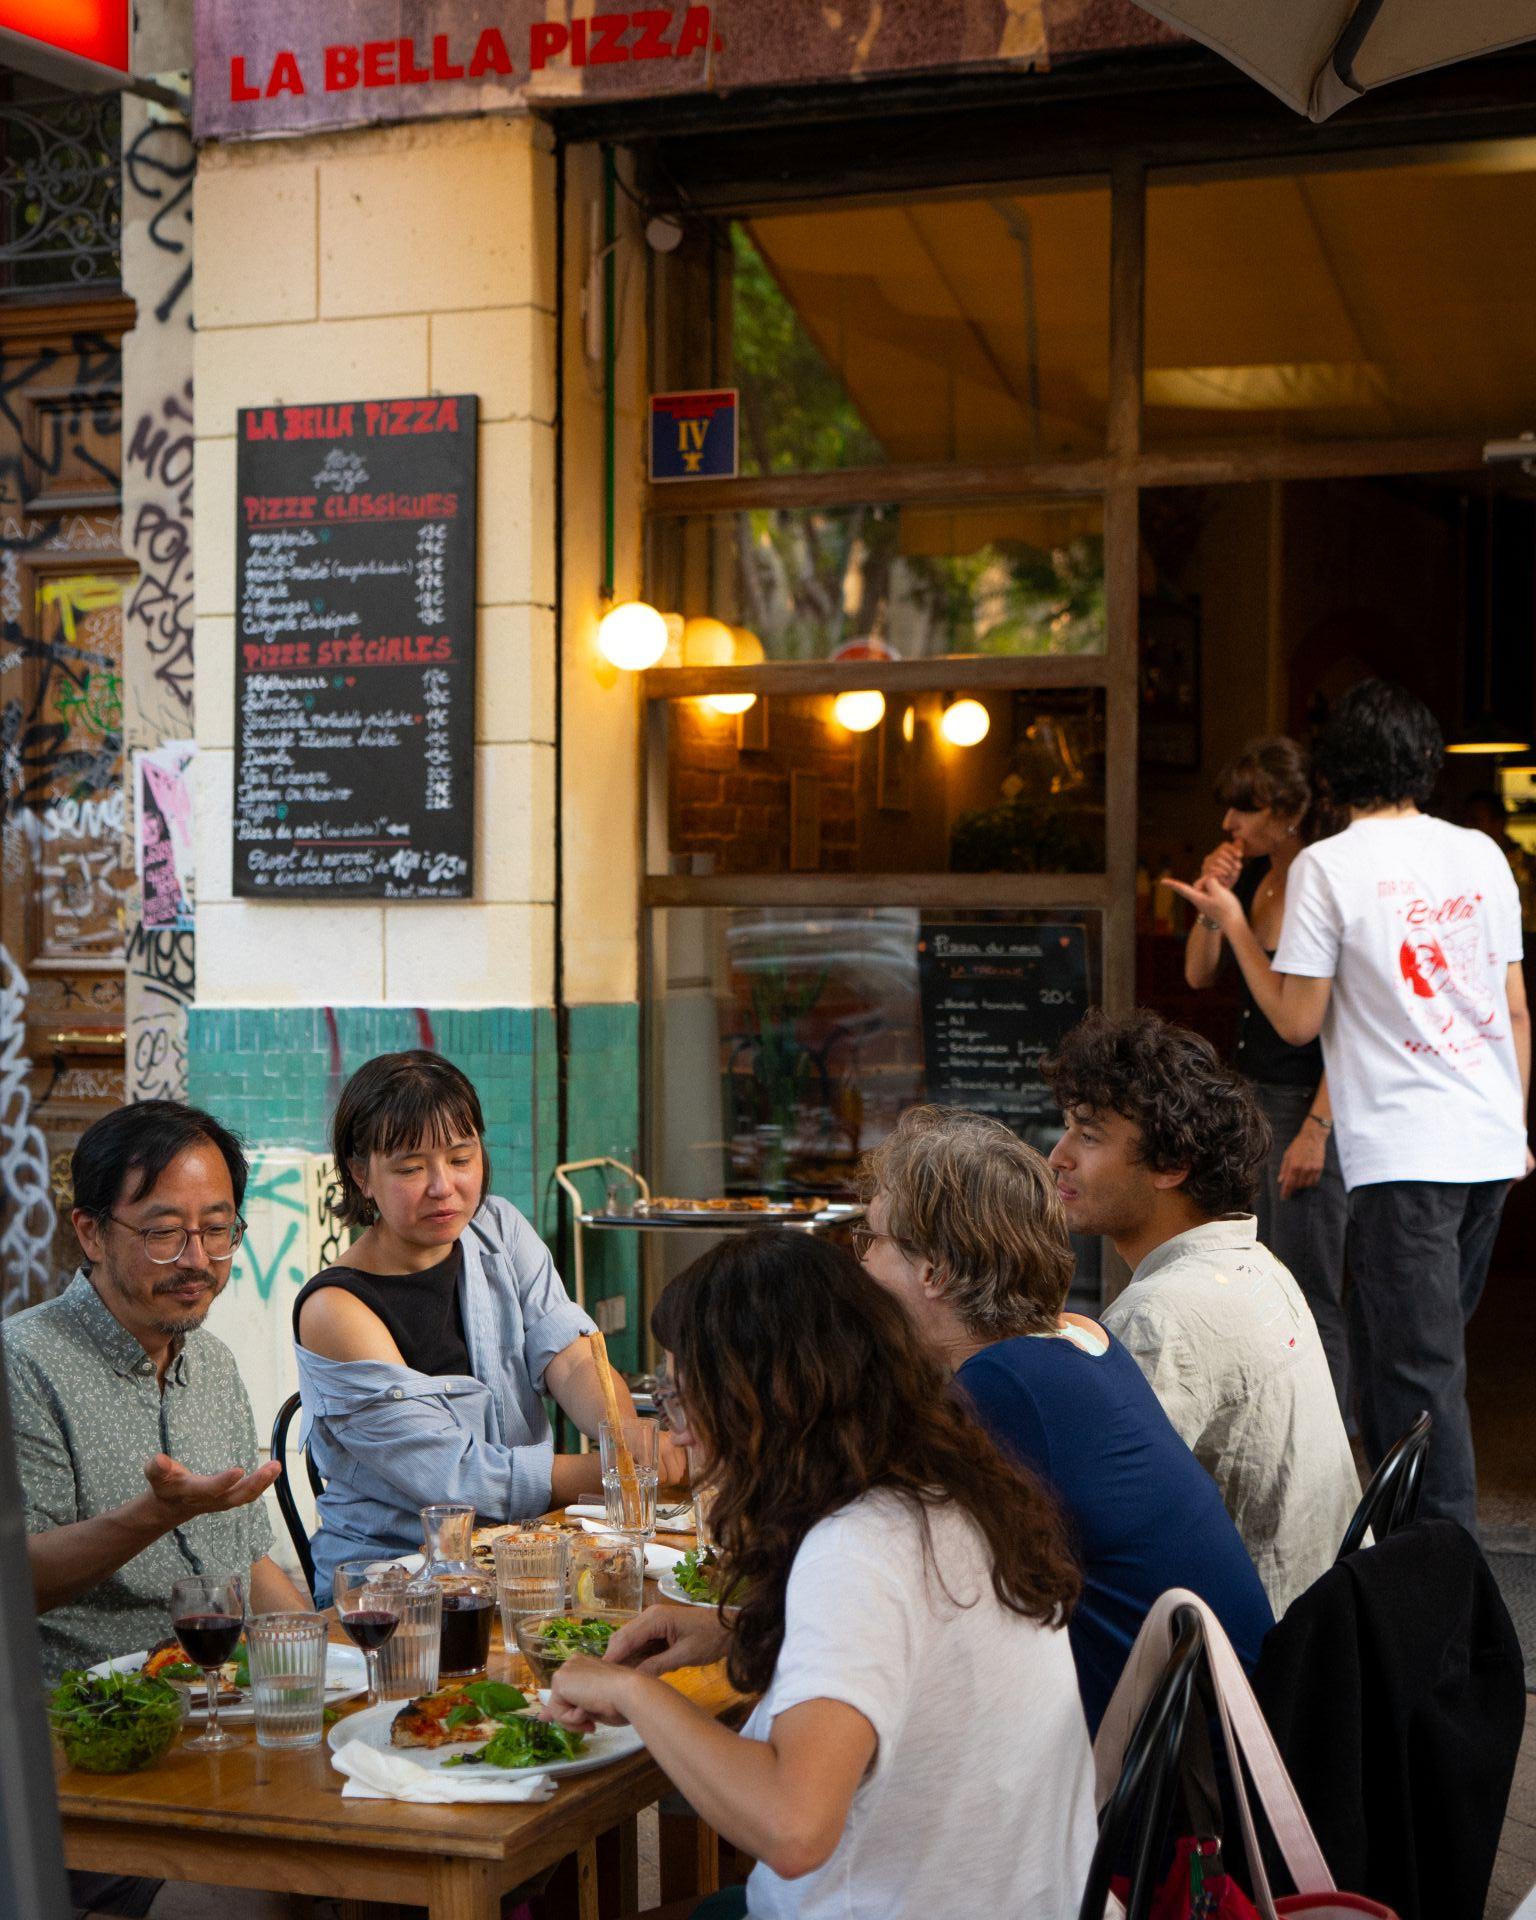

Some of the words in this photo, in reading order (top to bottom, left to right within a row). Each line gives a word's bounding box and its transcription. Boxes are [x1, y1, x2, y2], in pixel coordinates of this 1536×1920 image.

[231, 52, 305, 102] LA
[325, 28, 512, 91] BELLA
[530, 6, 722, 71] PIZZA
[246, 410, 278, 441] LA
[283, 404, 355, 441] BELLA
[678, 419, 711, 452] IV
